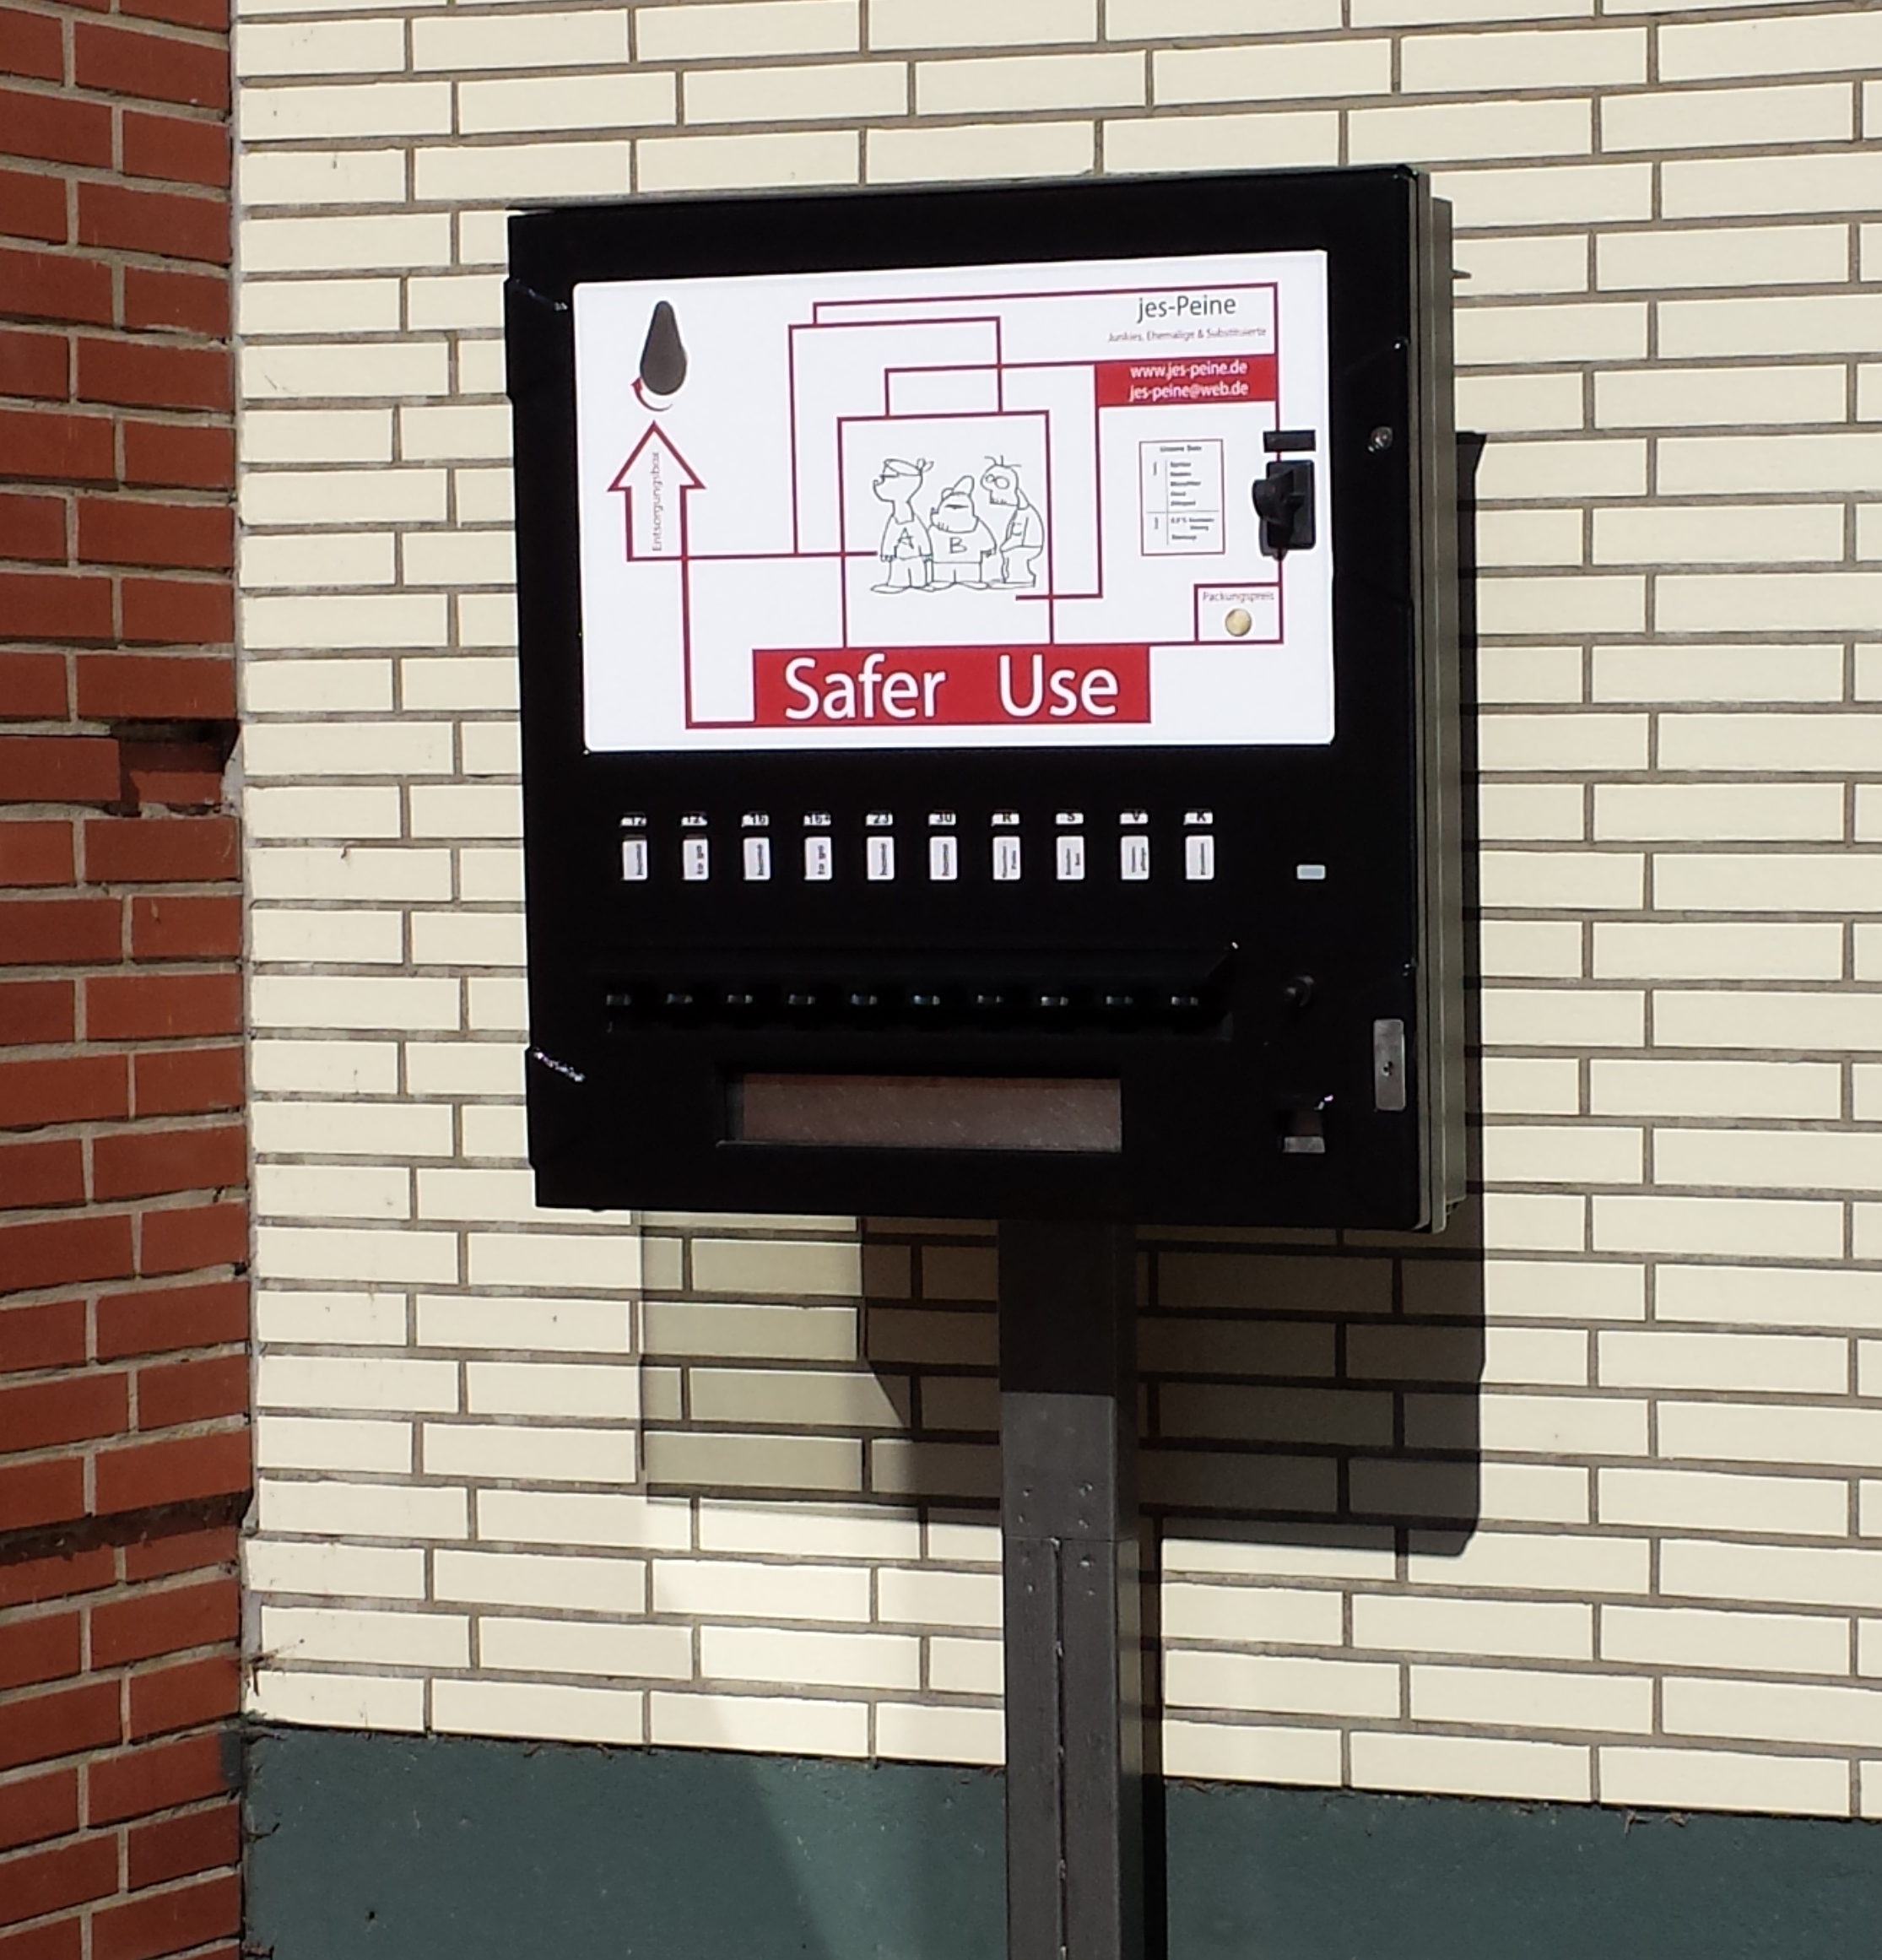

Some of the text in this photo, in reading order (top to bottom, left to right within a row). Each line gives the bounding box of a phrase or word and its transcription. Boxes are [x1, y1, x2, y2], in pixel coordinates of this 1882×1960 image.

[1137, 294, 1236, 323] jes-Peine
[1146, 329, 1195, 342] Ehemalige
[1129, 360, 1248, 381] www.jes-peine.de
[1128, 381, 1250, 402] jes-peine@web.de
[949, 537, 968, 554] B
[783, 652, 1120, 722] Safer Use
